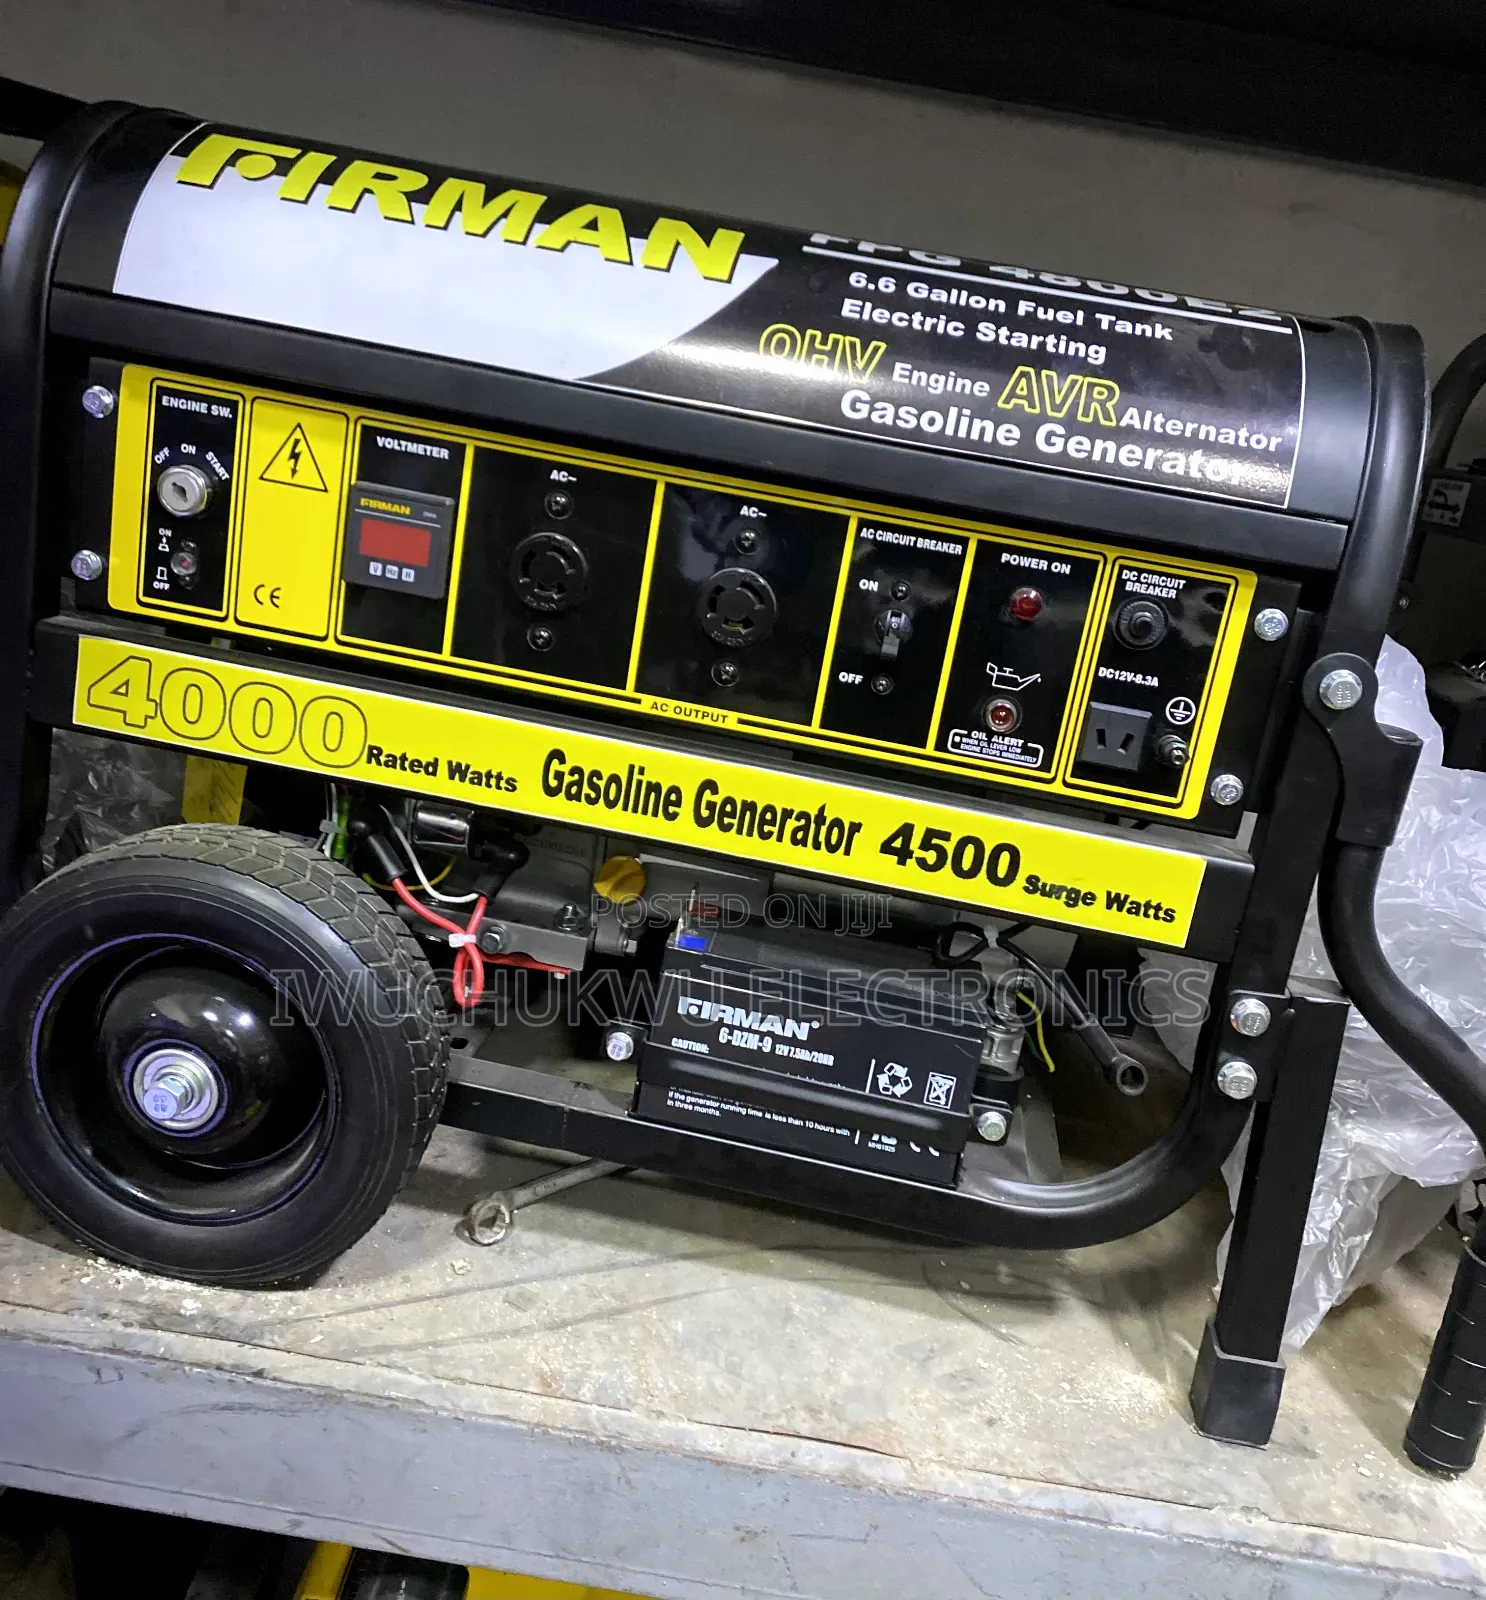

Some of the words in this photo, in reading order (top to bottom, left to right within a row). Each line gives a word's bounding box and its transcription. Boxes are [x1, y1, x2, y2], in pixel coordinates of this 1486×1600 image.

[175, 133, 745, 283] FIRMAN
[848, 271, 897, 294] 6.6
[906, 281, 1007, 314] Gallon
[1016, 299, 1085, 327] Fuel
[1094, 312, 1174, 341] Tank
[840, 297, 966, 338] Electric
[975, 320, 1108, 366] Starting
[757, 322, 888, 385] OHV
[891, 361, 991, 398] Engine
[996, 365, 1121, 427] AVR
[1119, 406, 1284, 453] Alternator
[161, 395, 208, 415] ENGINE
[210, 403, 233, 419] SW.
[376, 435, 450, 461] VOLTMETER
[840, 388, 1022, 447] Gasoline
[1034, 421, 1246, 487] Generator
[154, 446, 171, 465] OFF
[180, 443, 197, 455] ON
[204, 451, 231, 482] START
[360, 497, 412, 516] FIRMAN
[158, 527, 172, 538] ON
[860, 527, 875, 540] AC
[875, 530, 916, 548] CIRCUIT
[916, 537, 963, 556] BREAKER
[1001, 552, 1049, 572] POWER
[1051, 561, 1071, 575] ON
[153, 580, 170, 591] OFF
[859, 578, 879, 592] ON
[1122, 569, 1137, 582] DC
[1139, 572, 1186, 589] CIRCUIT
[1125, 581, 1177, 599] BREAKER
[838, 672, 863, 686] OFF
[1098, 666, 1159, 687] DC12V-8.3A
[650, 701, 670, 713] AC
[673, 706, 729, 725] OUTPUT
[961, 737, 979, 745] WHEN
[971, 730, 988, 741] OIL
[991, 734, 1025, 747] ALERT
[960, 743, 981, 752] ENGINE
[982, 747, 1001, 757] STOPS
[87, 655, 368, 769] 4000
[365, 744, 439, 778] Rated
[446, 760, 518, 793] Watts
[541, 748, 682, 822] Gasoline
[692, 778, 863, 857] Generator
[879, 822, 1021, 888] 4500
[1024, 873, 1097, 909] Surge
[1105, 889, 1177, 924] Watts
[671, 1037, 710, 1054] CAUTION:
[718, 1026, 773, 1053] 6-DZM-9
[674, 1100, 693, 1112] three
[693, 1105, 722, 1117] months.
[674, 1091, 686, 1100] the
[686, 1095, 720, 1109] generator
[720, 1102, 747, 1115] running
[747, 1107, 763, 1118] time
[764, 1111, 772, 1120] is
[772, 1113, 787, 1123] less
[787, 1116, 804, 1127] than
[805, 1119, 814, 1128] 10
[814, 1122, 835, 1134] hours
[835, 1127, 850, 1137] with
